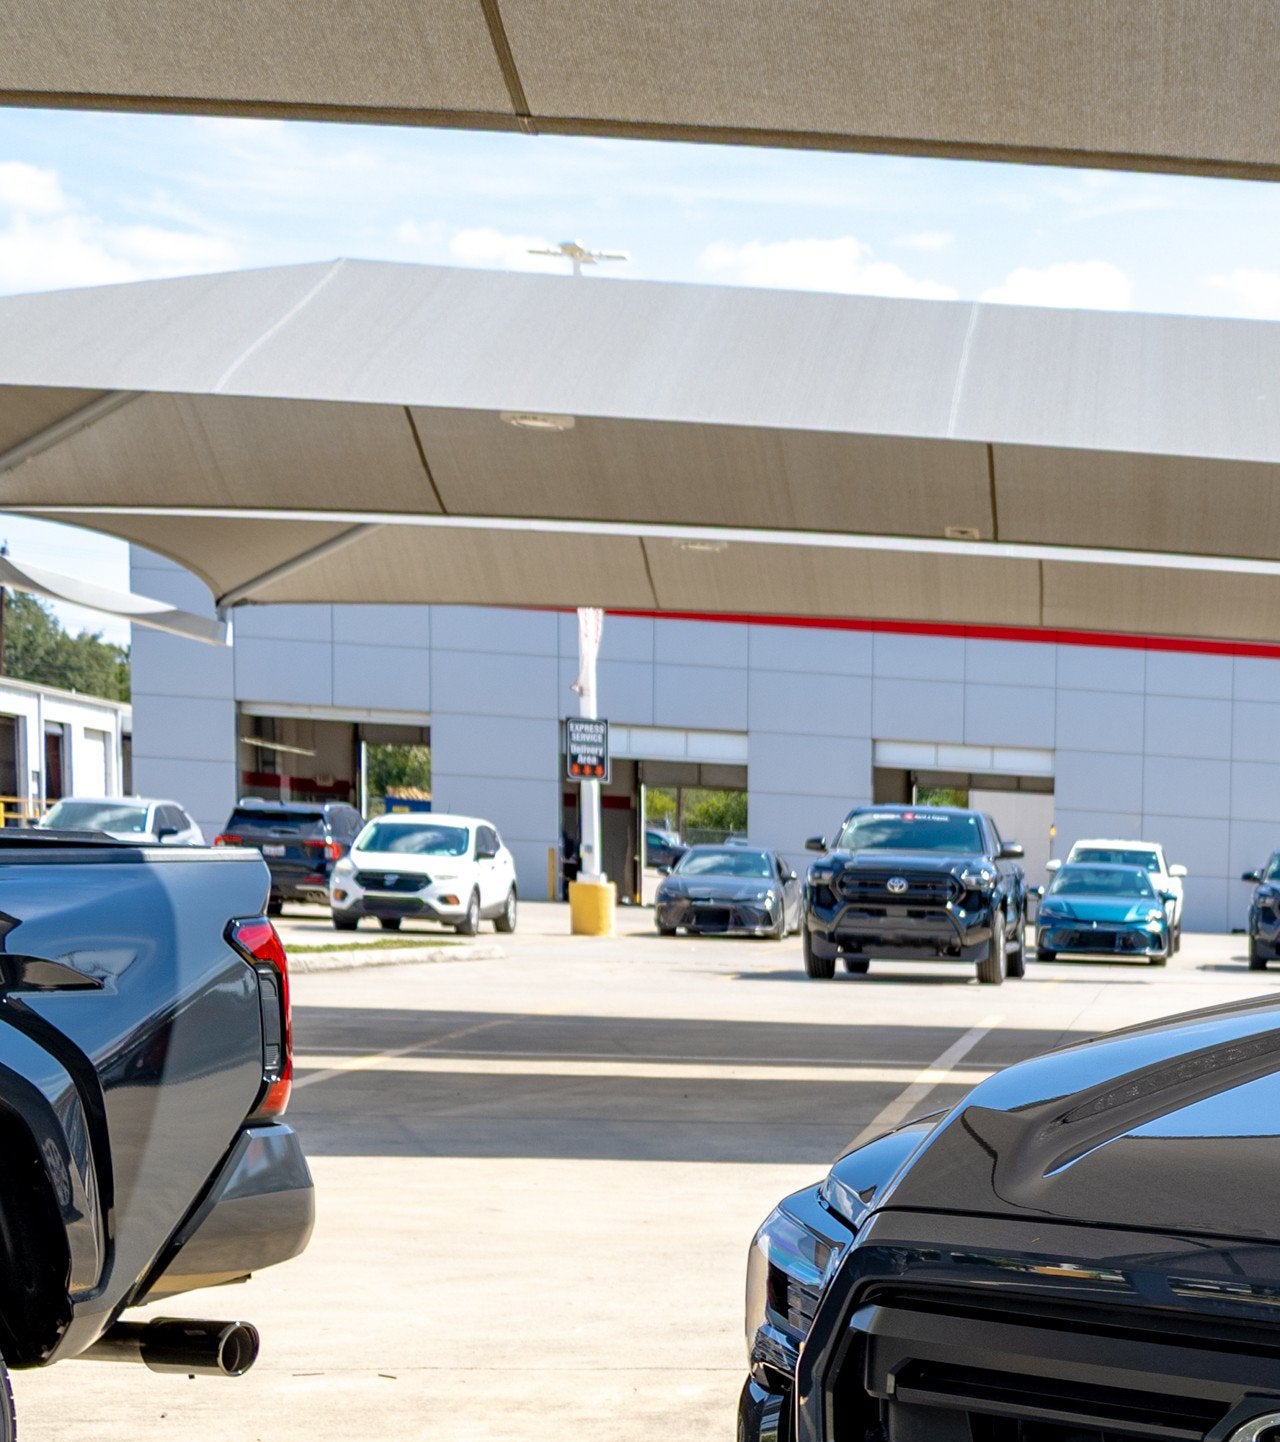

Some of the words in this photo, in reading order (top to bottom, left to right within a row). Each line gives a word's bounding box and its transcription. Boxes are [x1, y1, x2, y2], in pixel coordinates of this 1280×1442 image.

[570, 723, 604, 734] EXPRESS
[571, 733, 603, 742] SERVICE
[571, 744, 603, 756] Delivery
[577, 755, 597, 764] Area
